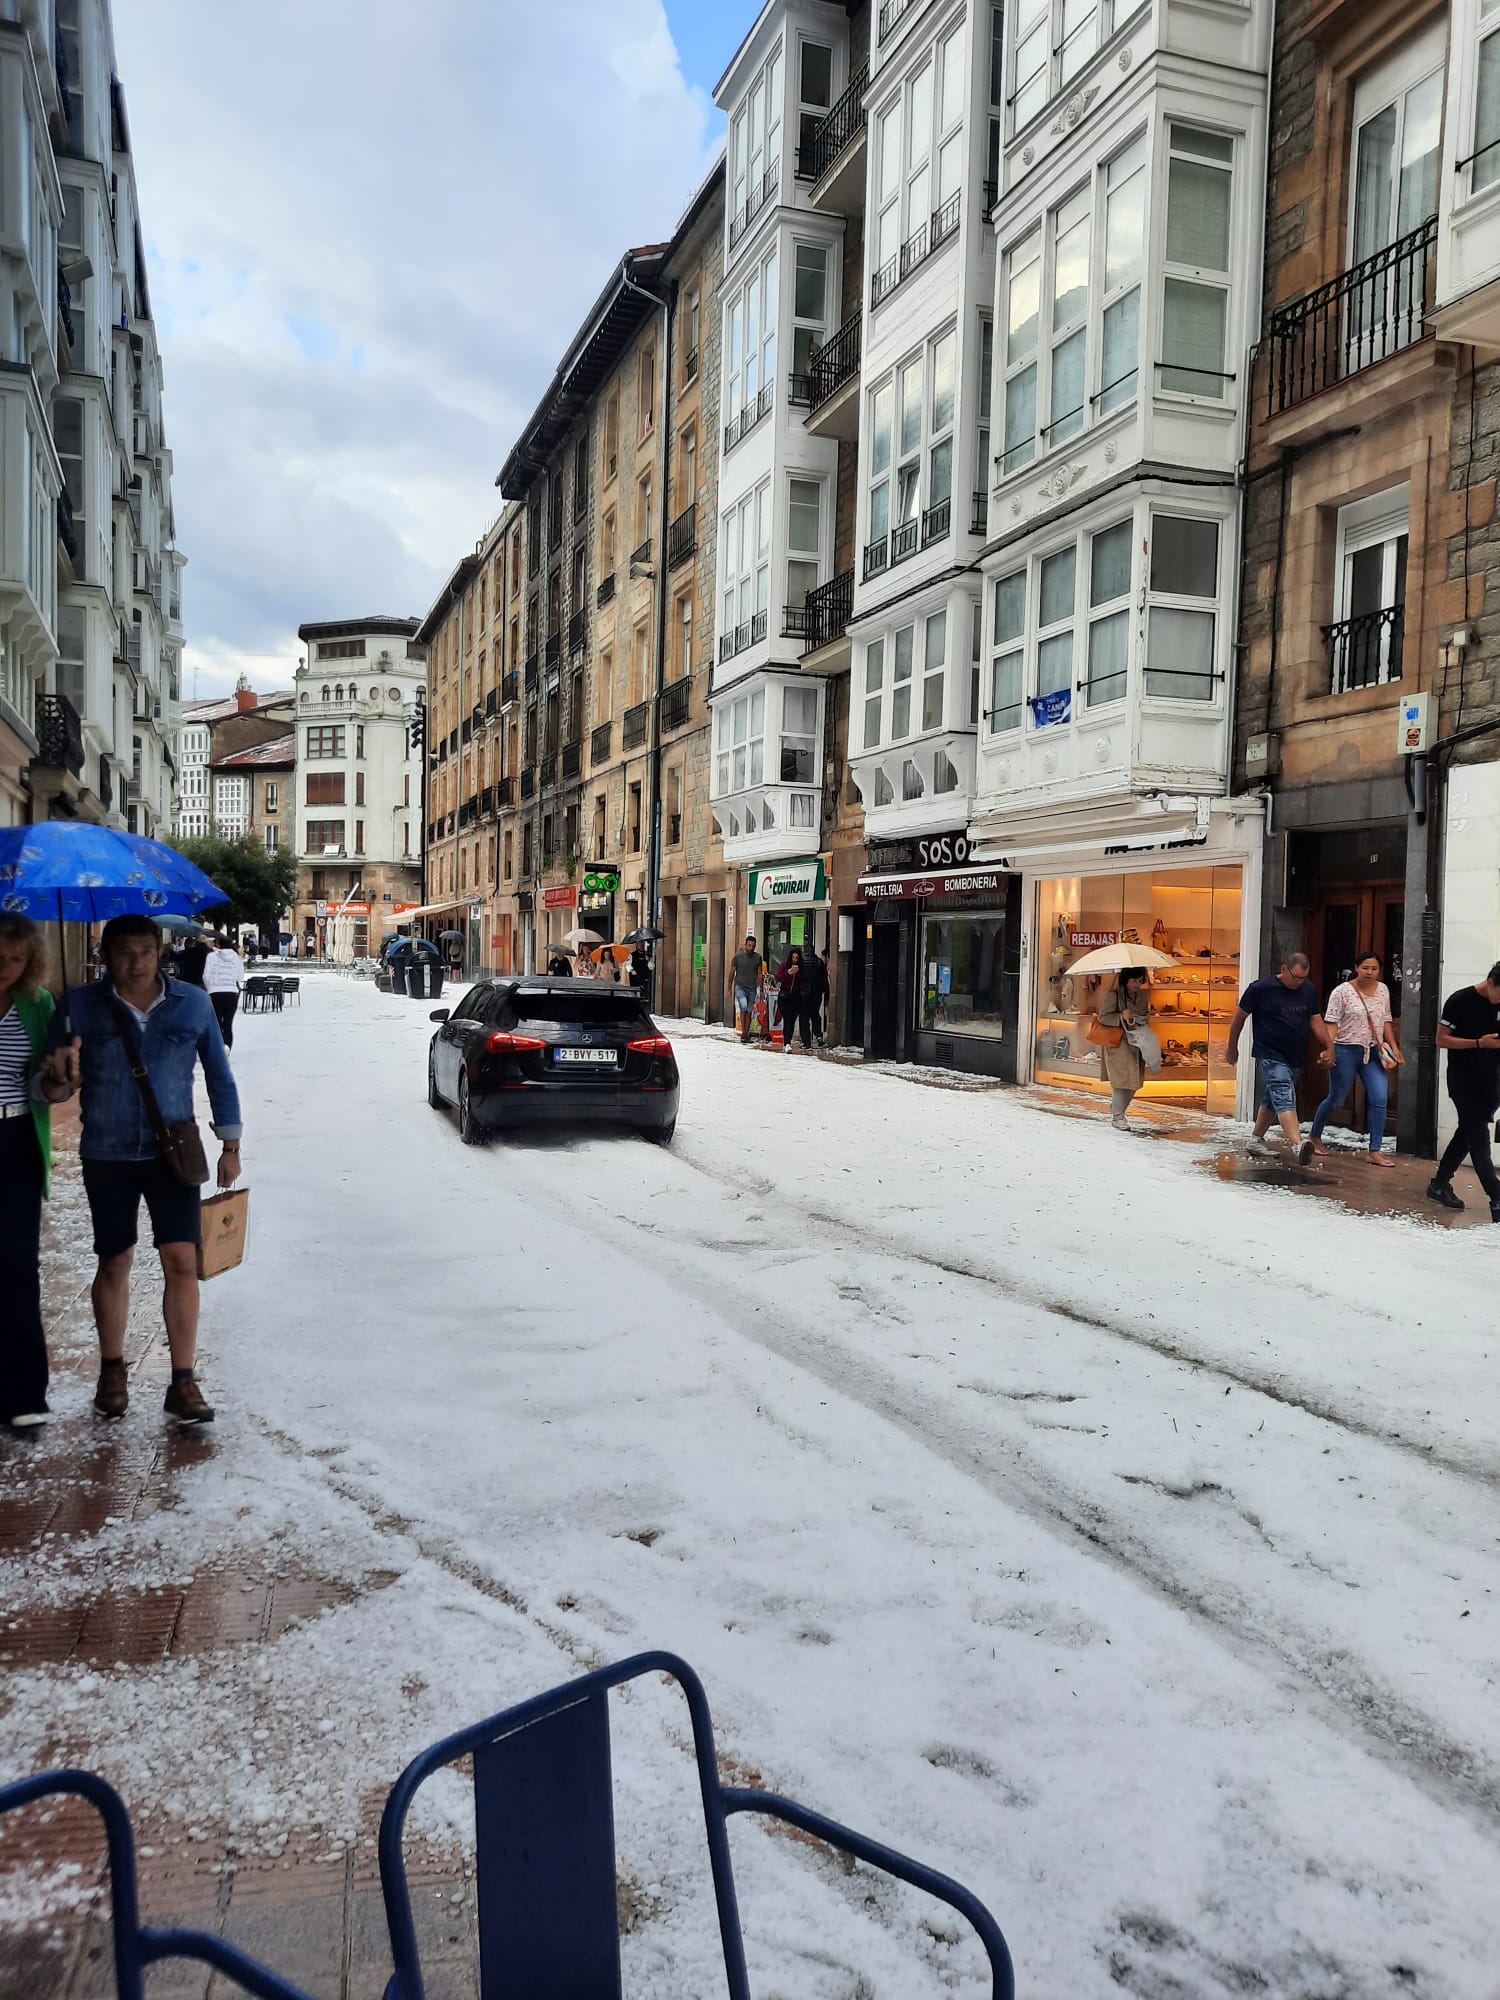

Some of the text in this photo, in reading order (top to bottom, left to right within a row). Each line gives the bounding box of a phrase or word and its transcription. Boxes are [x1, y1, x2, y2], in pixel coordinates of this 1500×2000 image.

[772, 879, 810, 896] COVIRAN
[864, 883, 904, 897] PASTELERIA
[944, 875, 998, 892] BOMBONERIA
[1071, 933, 1115, 946] REBAJAS
